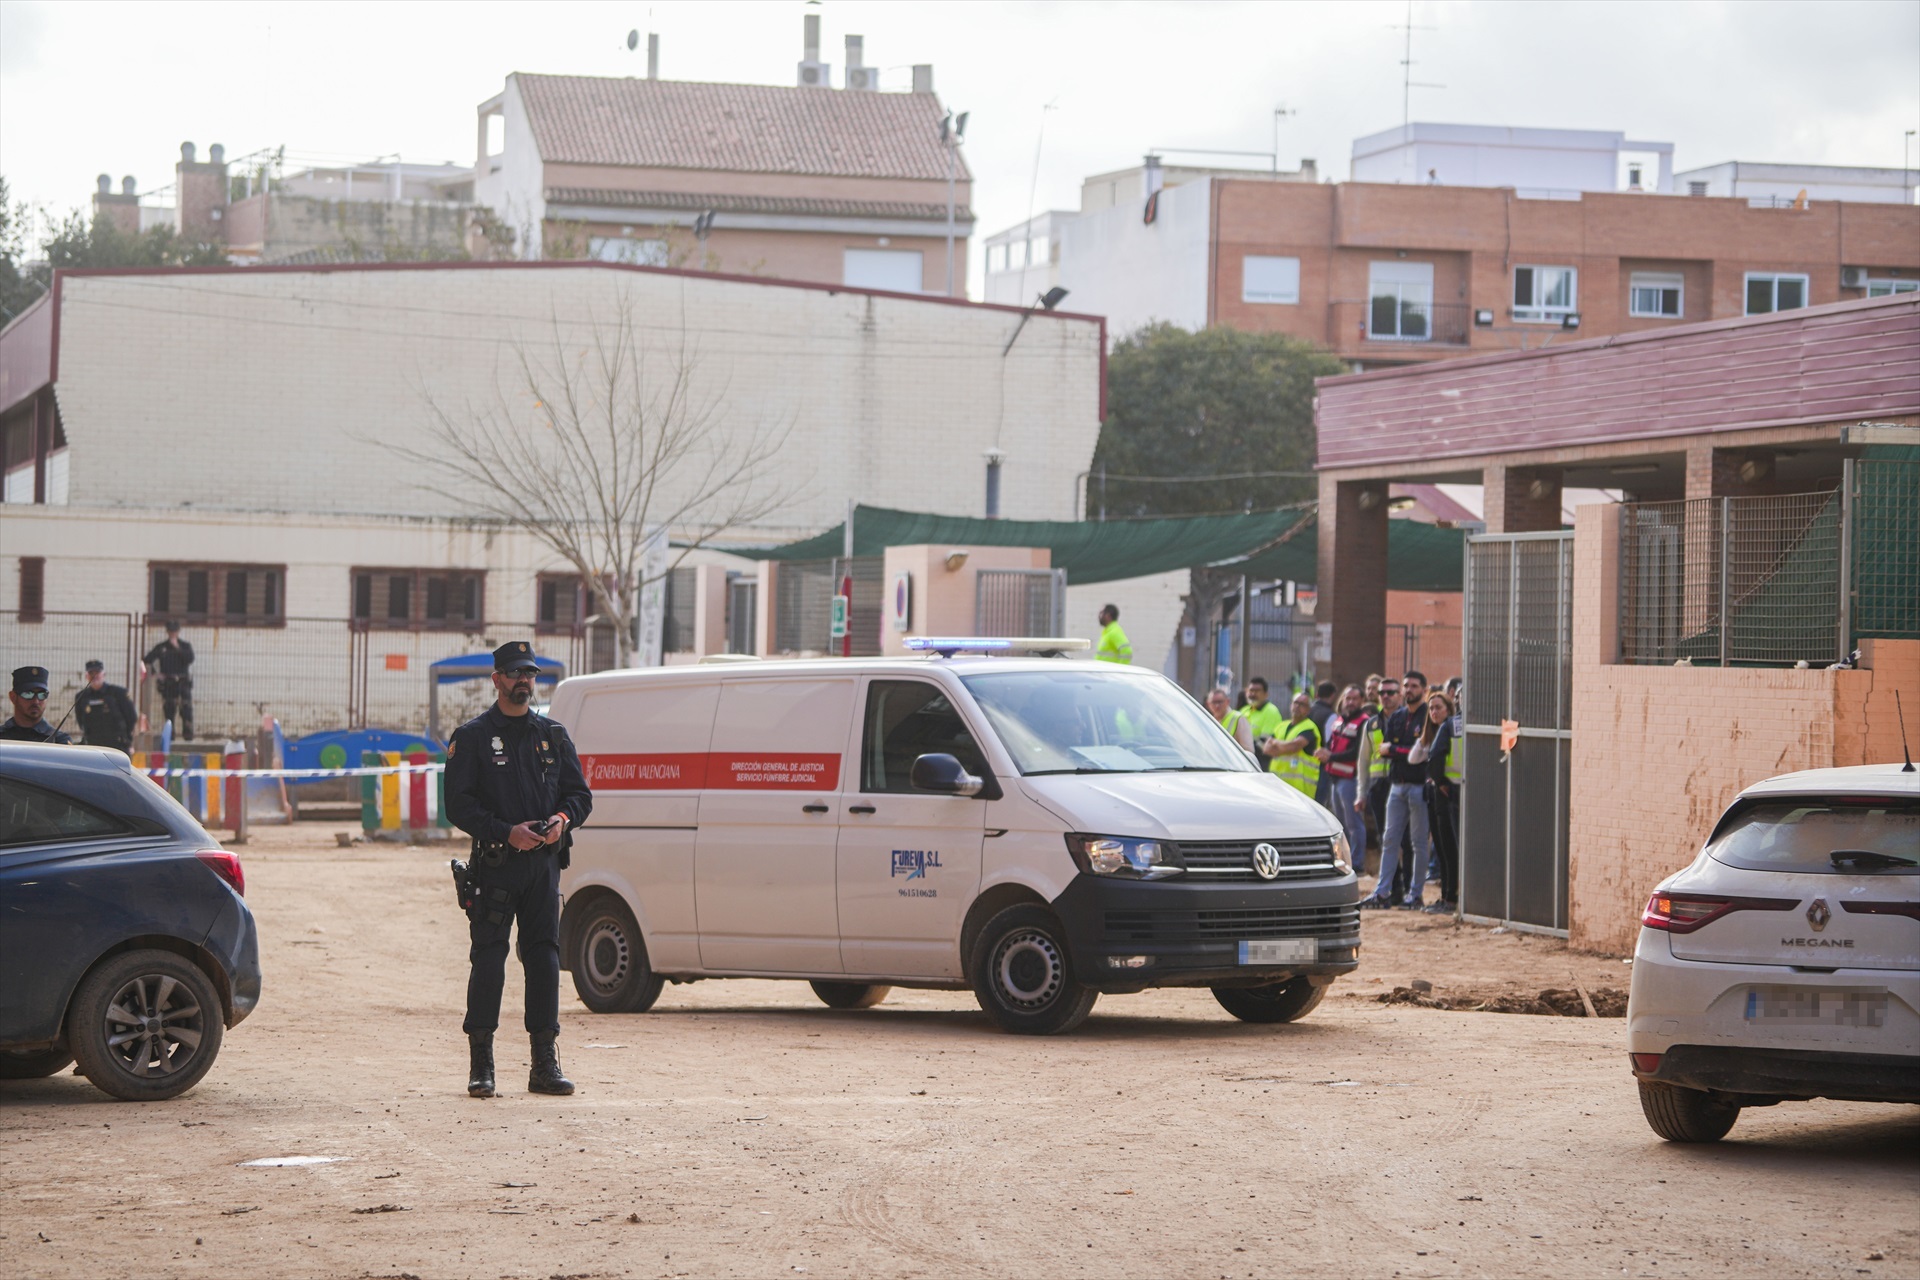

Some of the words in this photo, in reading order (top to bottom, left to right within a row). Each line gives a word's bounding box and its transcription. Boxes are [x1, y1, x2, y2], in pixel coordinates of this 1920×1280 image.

[731, 761, 761, 771] DIRECCIÓN
[762, 762, 789, 771] GENERAL
[790, 763, 798, 771] DE
[799, 763, 825, 772] JUSTICIA
[595, 764, 636, 780] GENERALITAT
[639, 764, 680, 779] VALENCIANA
[736, 773, 762, 782] SERVICIO
[790, 774, 816, 783] JUDICIAL
[1781, 938, 1855, 948] MEGANE
